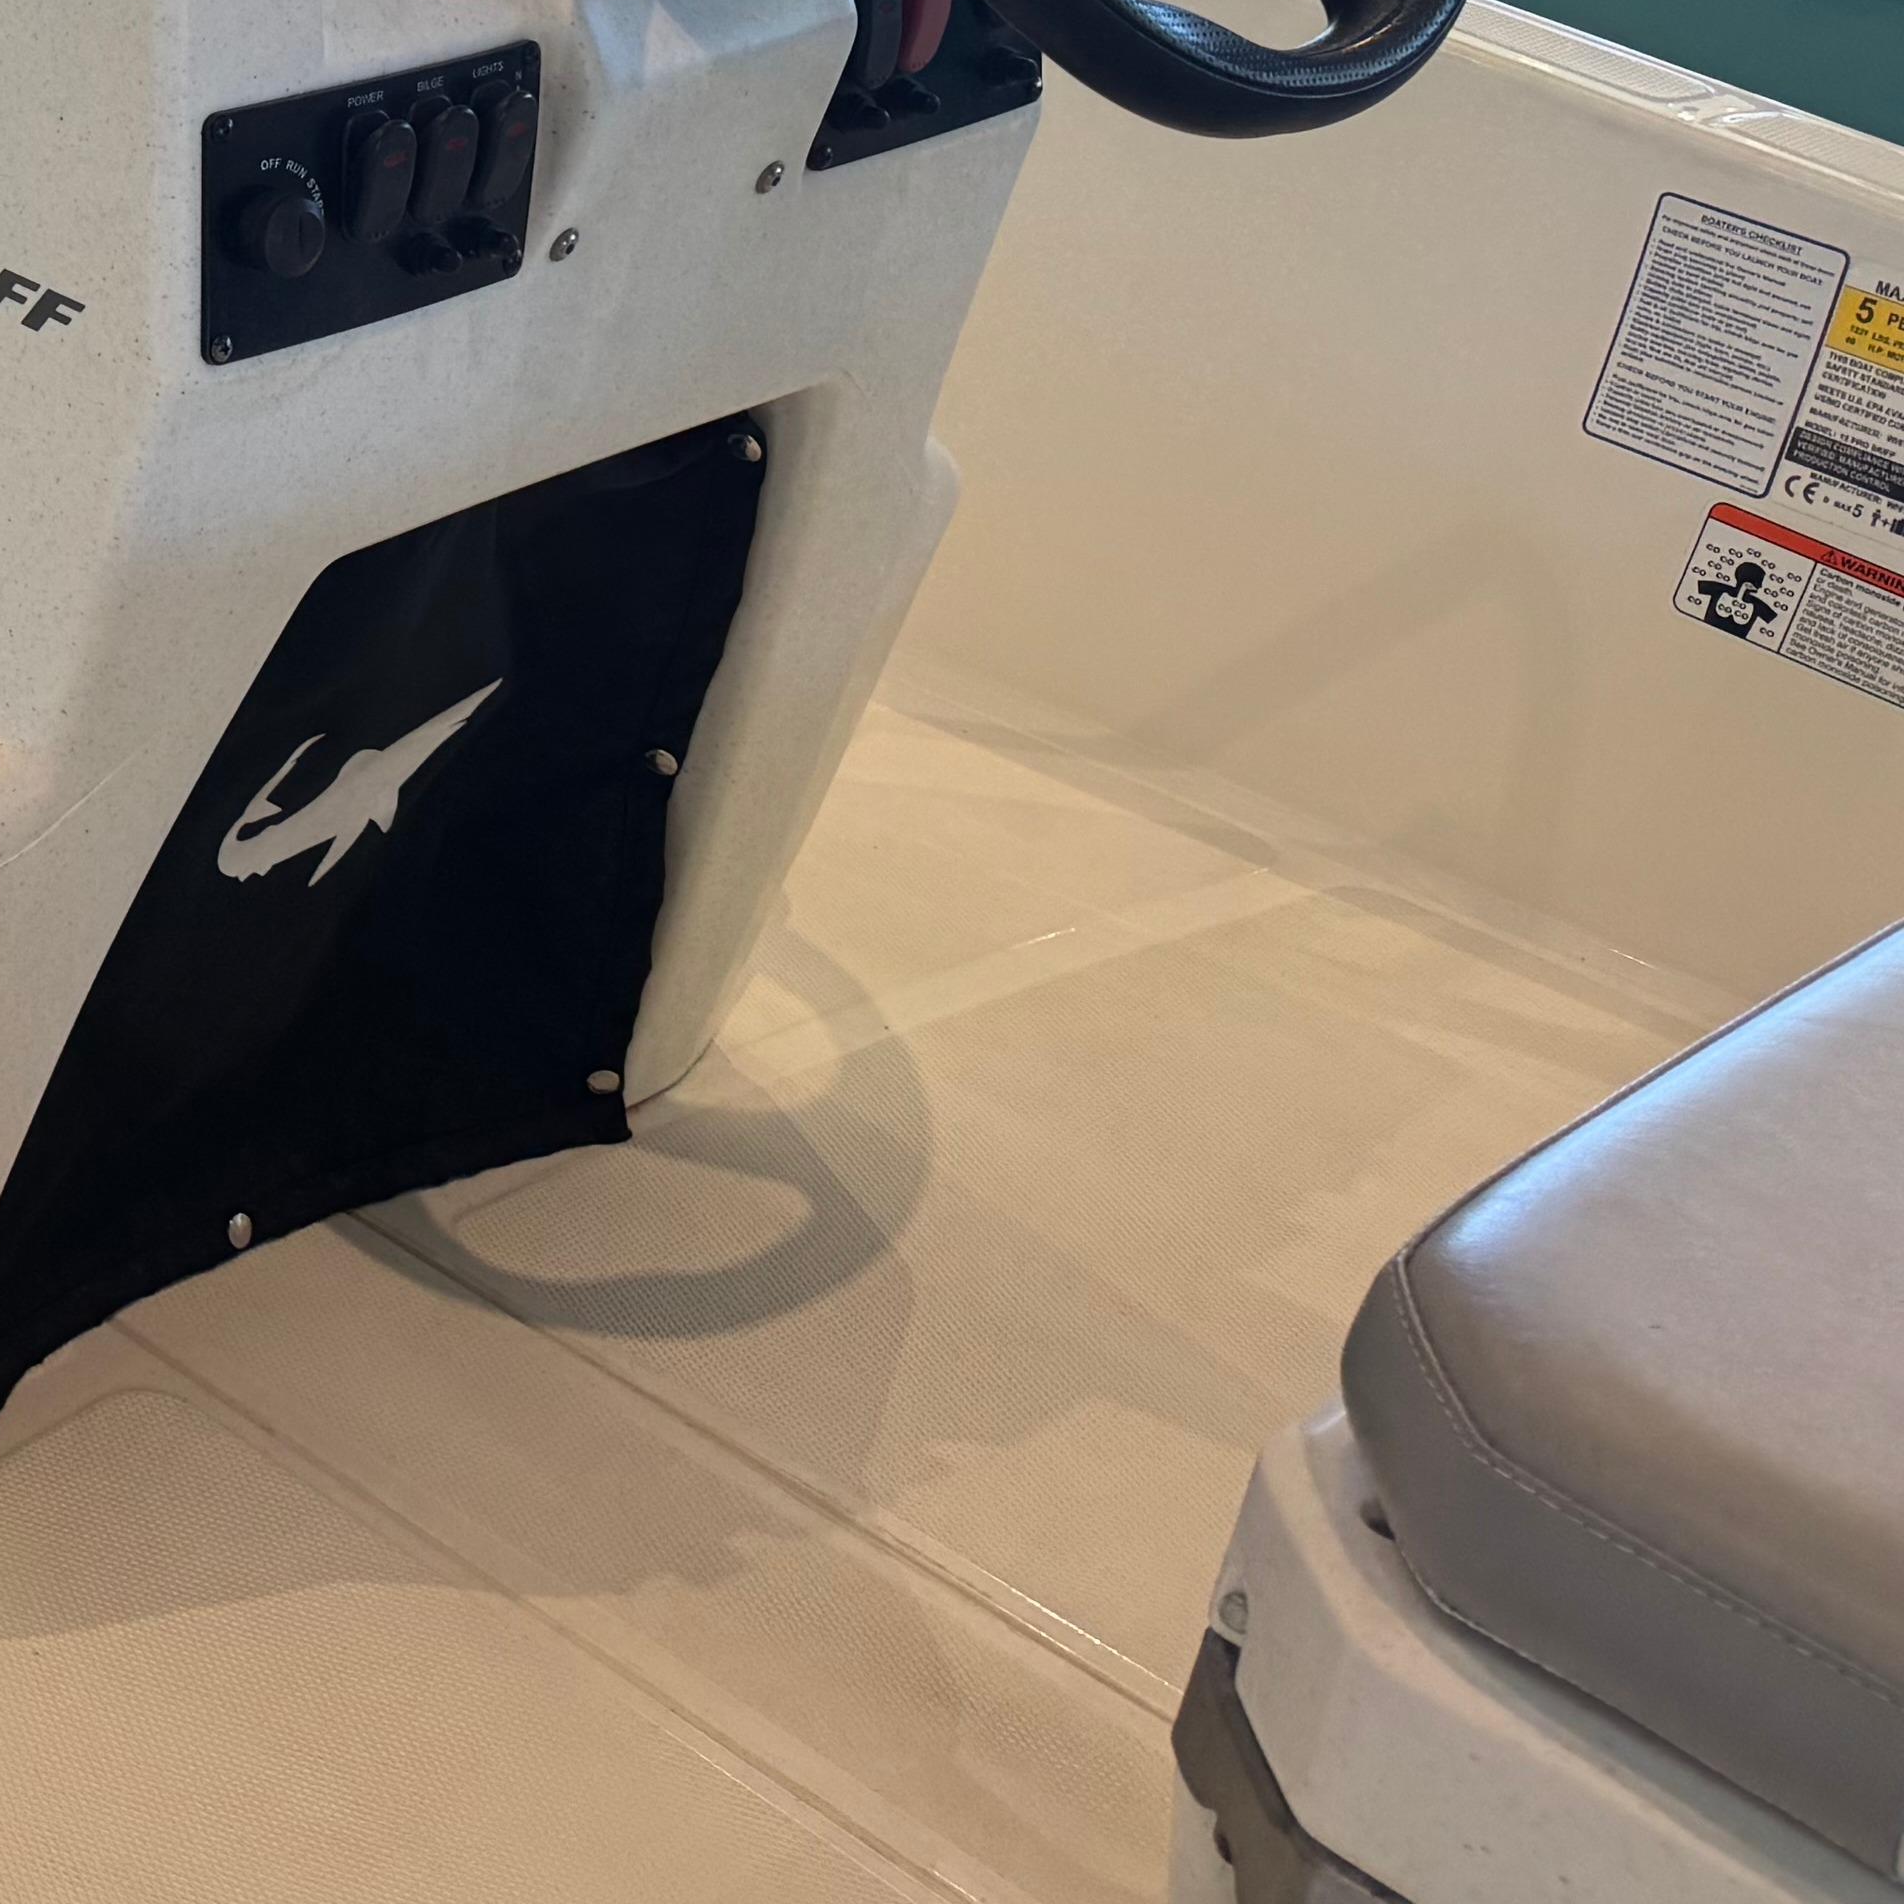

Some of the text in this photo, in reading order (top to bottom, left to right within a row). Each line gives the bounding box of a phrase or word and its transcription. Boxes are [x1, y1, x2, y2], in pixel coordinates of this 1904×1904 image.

[472, 60, 504, 80] LIGHTS
[416, 76, 444, 93] BILGE
[348, 90, 385, 108] POWER
[260, 157, 282, 172] OFF
[285, 159, 308, 179] RUN
[1700, 214, 1803, 255] BOATER'S CHECKLIST
[1661, 226, 1822, 286] CHECK BEFORE YOU LAUNCH YOUR BOAT
[1855, 296, 1878, 324] 5
[1825, 361, 1858, 378] SAFETY
[1828, 351, 1849, 364] THIS
[1848, 359, 1873, 372] BOAT
[1616, 361, 1643, 375] CHECK
[1676, 383, 1693, 393] YOU
[1821, 371, 1886, 399] CERTIFICATION
[1841, 402, 1887, 424] CERTIFIED
[1848, 470, 1891, 492] CONTROL
[1852, 504, 1864, 518] 5
[1706, 543, 1721, 554] CO
[1729, 548, 1743, 558] CO
[1747, 548, 1762, 558] CO
[1707, 560, 1722, 570] CO
[1720, 556, 1734, 566] CO
[1761, 559, 1776, 569] CO
[1692, 566, 1706, 576] CO
[1716, 572, 1730, 582] CO
[1769, 573, 1784, 584] CO
[1787, 572, 1802, 582] CO
[1764, 588, 1779, 597] CO
[1780, 587, 1795, 597] CO
[1819, 567, 1901, 607] Carbon monoxide
[1687, 596, 1702, 605] CO
[1718, 604, 1732, 614] CO
[1732, 599, 1746, 609] CO
[1774, 601, 1788, 611] CO
[1844, 597, 1863, 609] and
[1734, 610, 1749, 620] CO
[1809, 592, 1826, 603] and
[1868, 616, 1900, 634] carbon
[1759, 627, 1775, 637] CO
[1798, 616, 1816, 627] and
[1817, 623, 1835, 635] lack
[1842, 615, 1874, 633] carbon
[1792, 631, 1835, 653] monoxide
[1795, 623, 1812, 634] Get
[1812, 630, 1836, 644] fresh
[1785, 647, 1817, 664] carbon
[1817, 660, 1861, 683] monoxide
[1789, 638, 1807, 649] See
[1844, 661, 1877, 681] Manual
[1878, 676, 1890, 686] for
